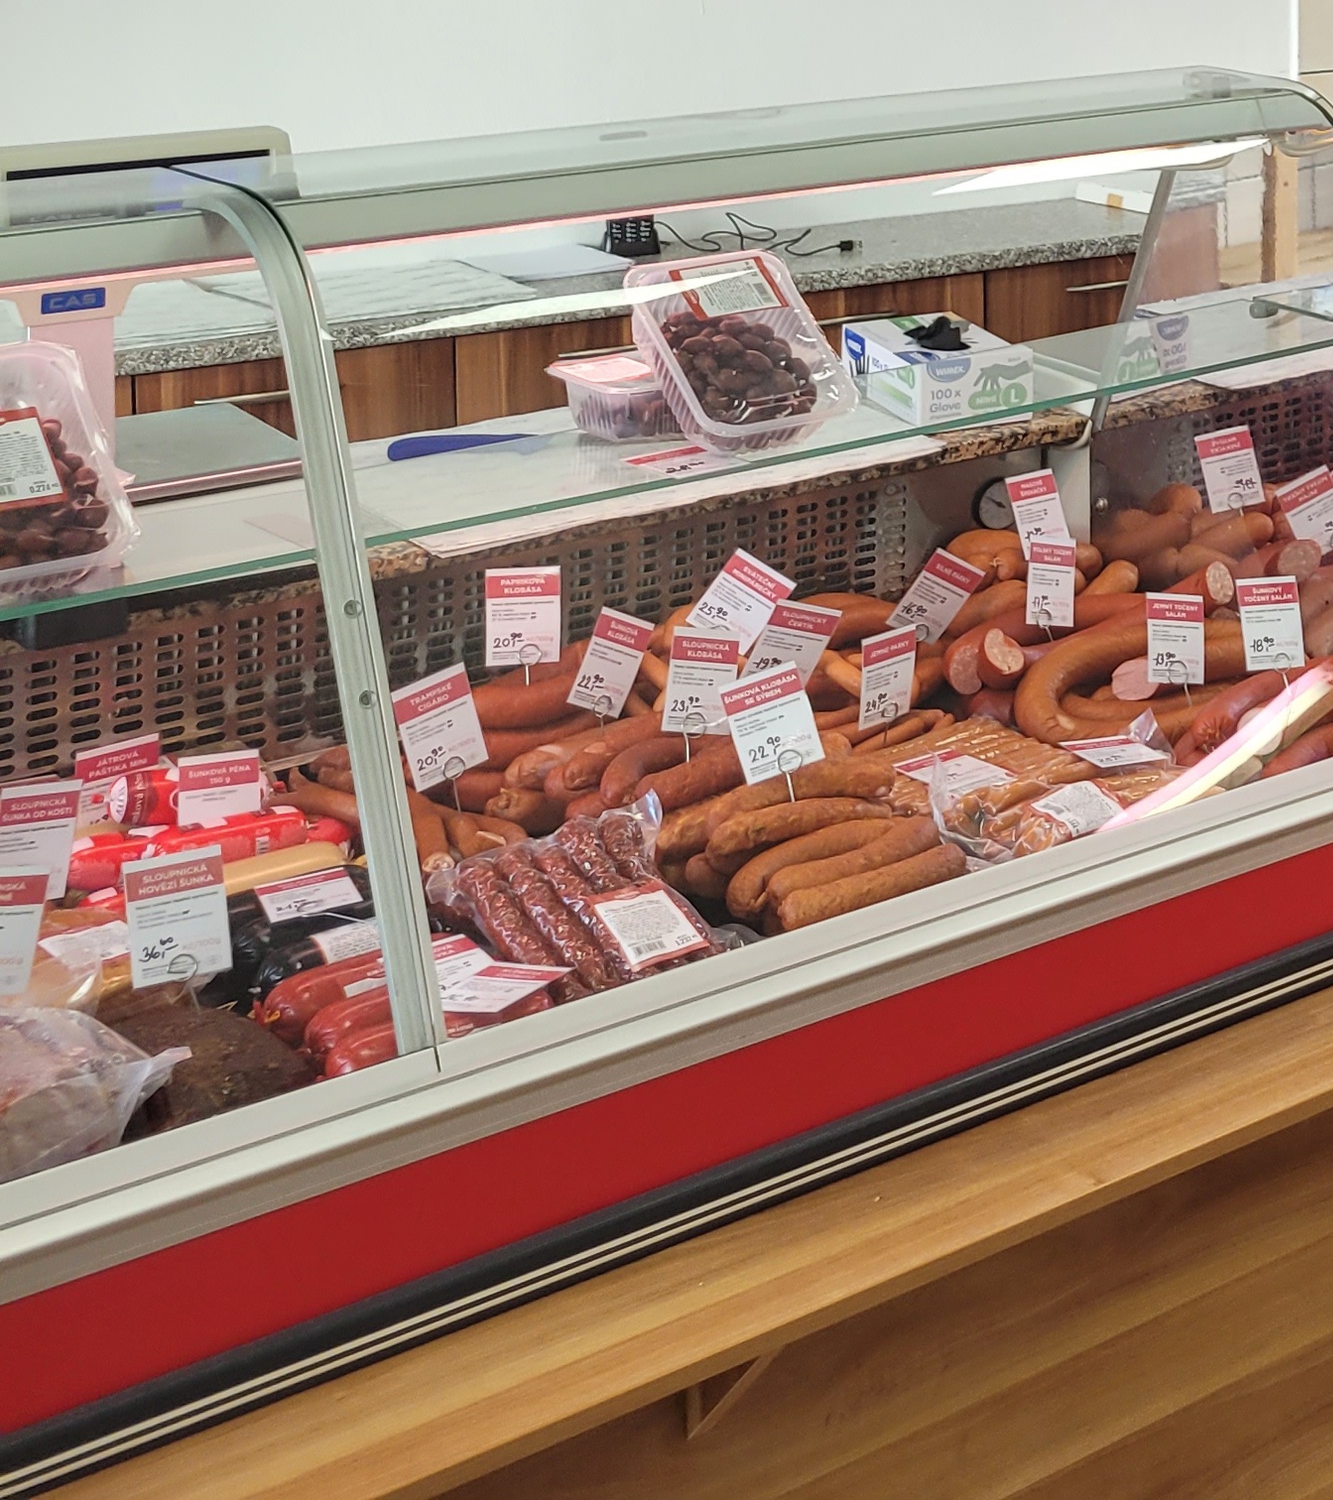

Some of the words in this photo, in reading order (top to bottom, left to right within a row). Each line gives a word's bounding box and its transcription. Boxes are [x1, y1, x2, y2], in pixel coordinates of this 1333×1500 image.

[50, 293, 96, 309] CAS
[935, 365, 965, 377] WIMEX
[930, 388, 953, 400] 100
[1009, 388, 1019, 402] L
[929, 401, 961, 413] Glove
[500, 575, 546, 587] PAPRIKOVÁ
[742, 563, 776, 591] SVÁTEČNÍ
[503, 584, 542, 595] KLOBÁSA
[1243, 593, 1271, 604] TOČENÝ
[1271, 590, 1295, 602] SALÁM
[1252, 585, 1283, 596] ŠUNKOVÝ
[1152, 601, 1175, 613] JEMNÝ
[1175, 603, 1200, 614] TOČENÝ
[1164, 609, 1187, 620] SALÁM
[787, 618, 815, 631] ČERTÍK
[682, 638, 730, 653] SLOUPNICKÁ
[687, 649, 723, 661] KLOBÁSA
[409, 682, 454, 707] TRAMPSKÉ
[723, 682, 761, 706] ŠUNKOVÁ
[759, 671, 798, 693] KLOBÁSA
[416, 692, 450, 713] CIGÁRO
[744, 696, 756, 707] SE
[755, 687, 783, 704] SÝREM
[96, 750, 139, 768] JÁTROVÁ
[88, 764, 128, 779] PAŠTIKA
[187, 766, 228, 780] ŠUNKOVÁ
[228, 763, 252, 775] PĚNA
[10, 795, 67, 812] SLOUPNICKÁ
[1, 810, 32, 823] ŠUNKA
[33, 809, 46, 820] OD
[47, 806, 73, 819] KOSTI
[142, 863, 209, 885] SLOUPNICKÁ
[138, 879, 178, 897] HOVĚZÍ
[179, 873, 215, 890] ŠUNKA
